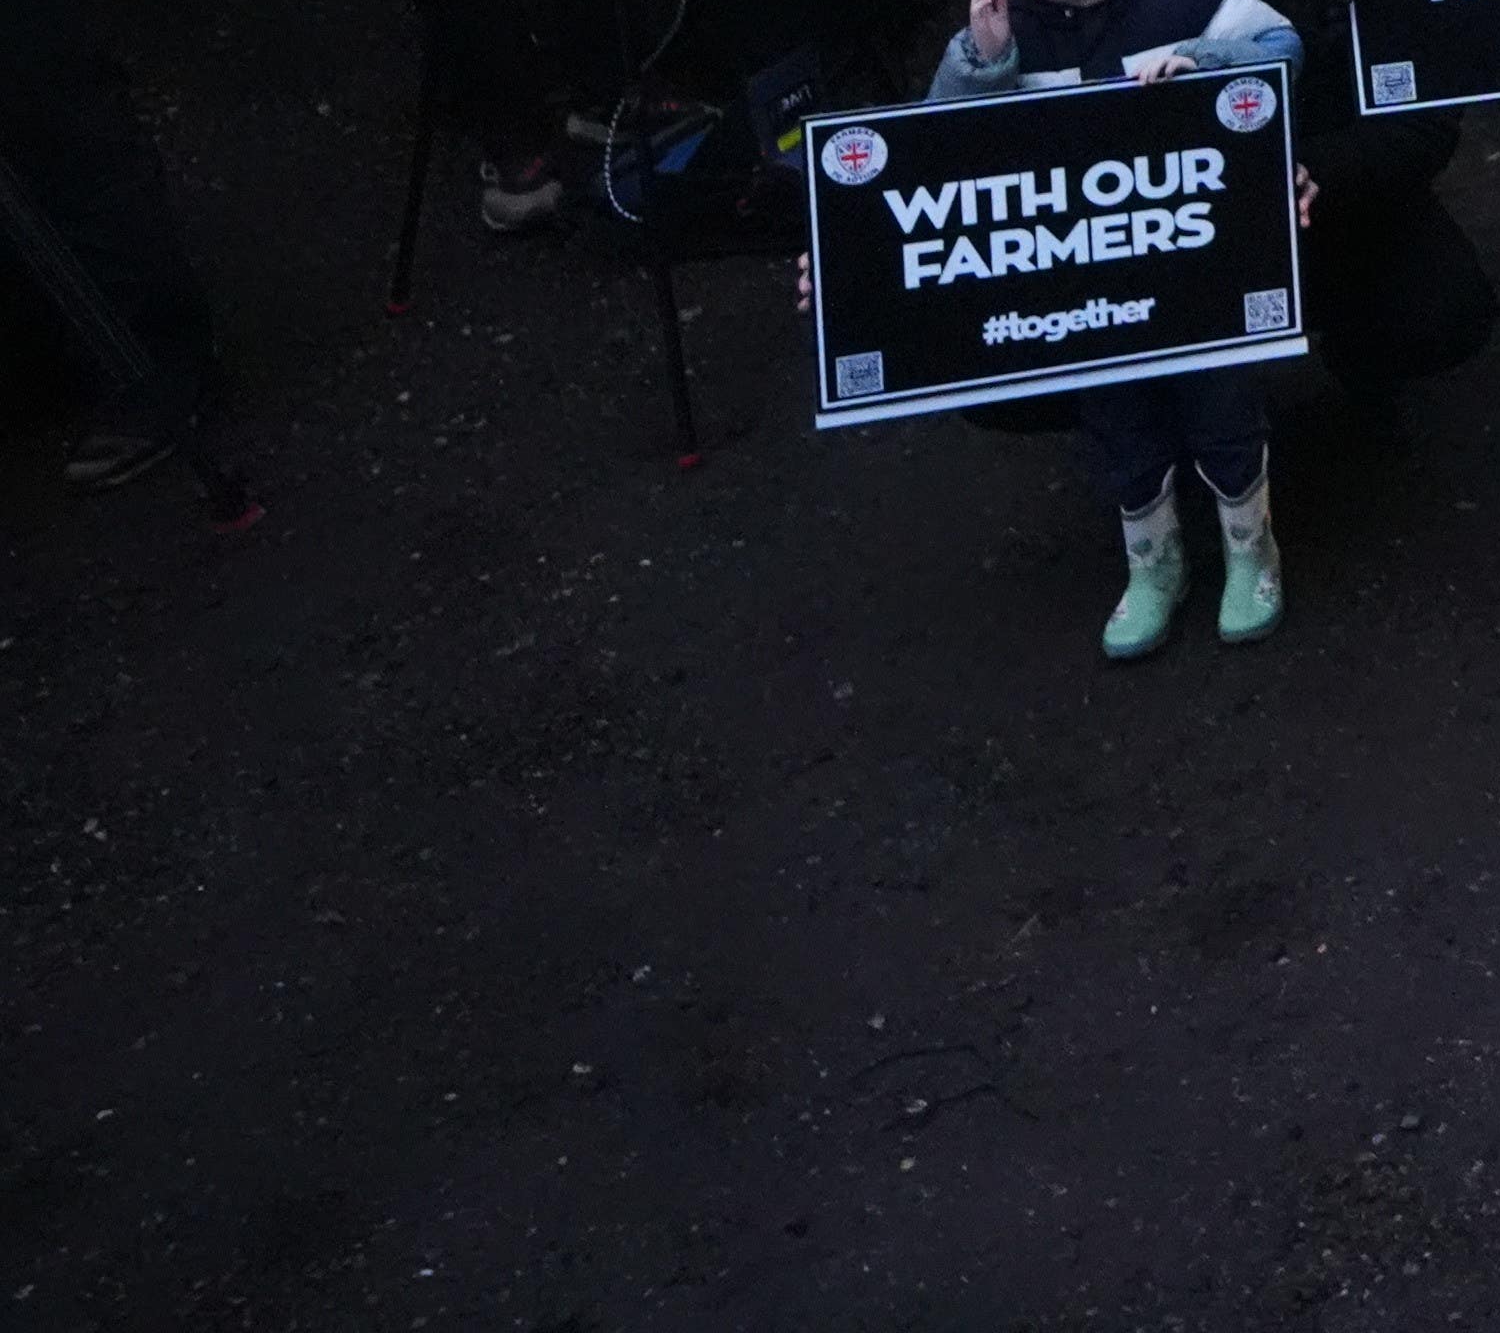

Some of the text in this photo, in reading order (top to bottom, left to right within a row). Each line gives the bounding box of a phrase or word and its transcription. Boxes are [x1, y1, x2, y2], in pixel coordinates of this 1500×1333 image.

[883, 148, 1225, 233] WITH OUR
[903, 202, 1215, 289] FARMERS
[983, 298, 1155, 345] #together
